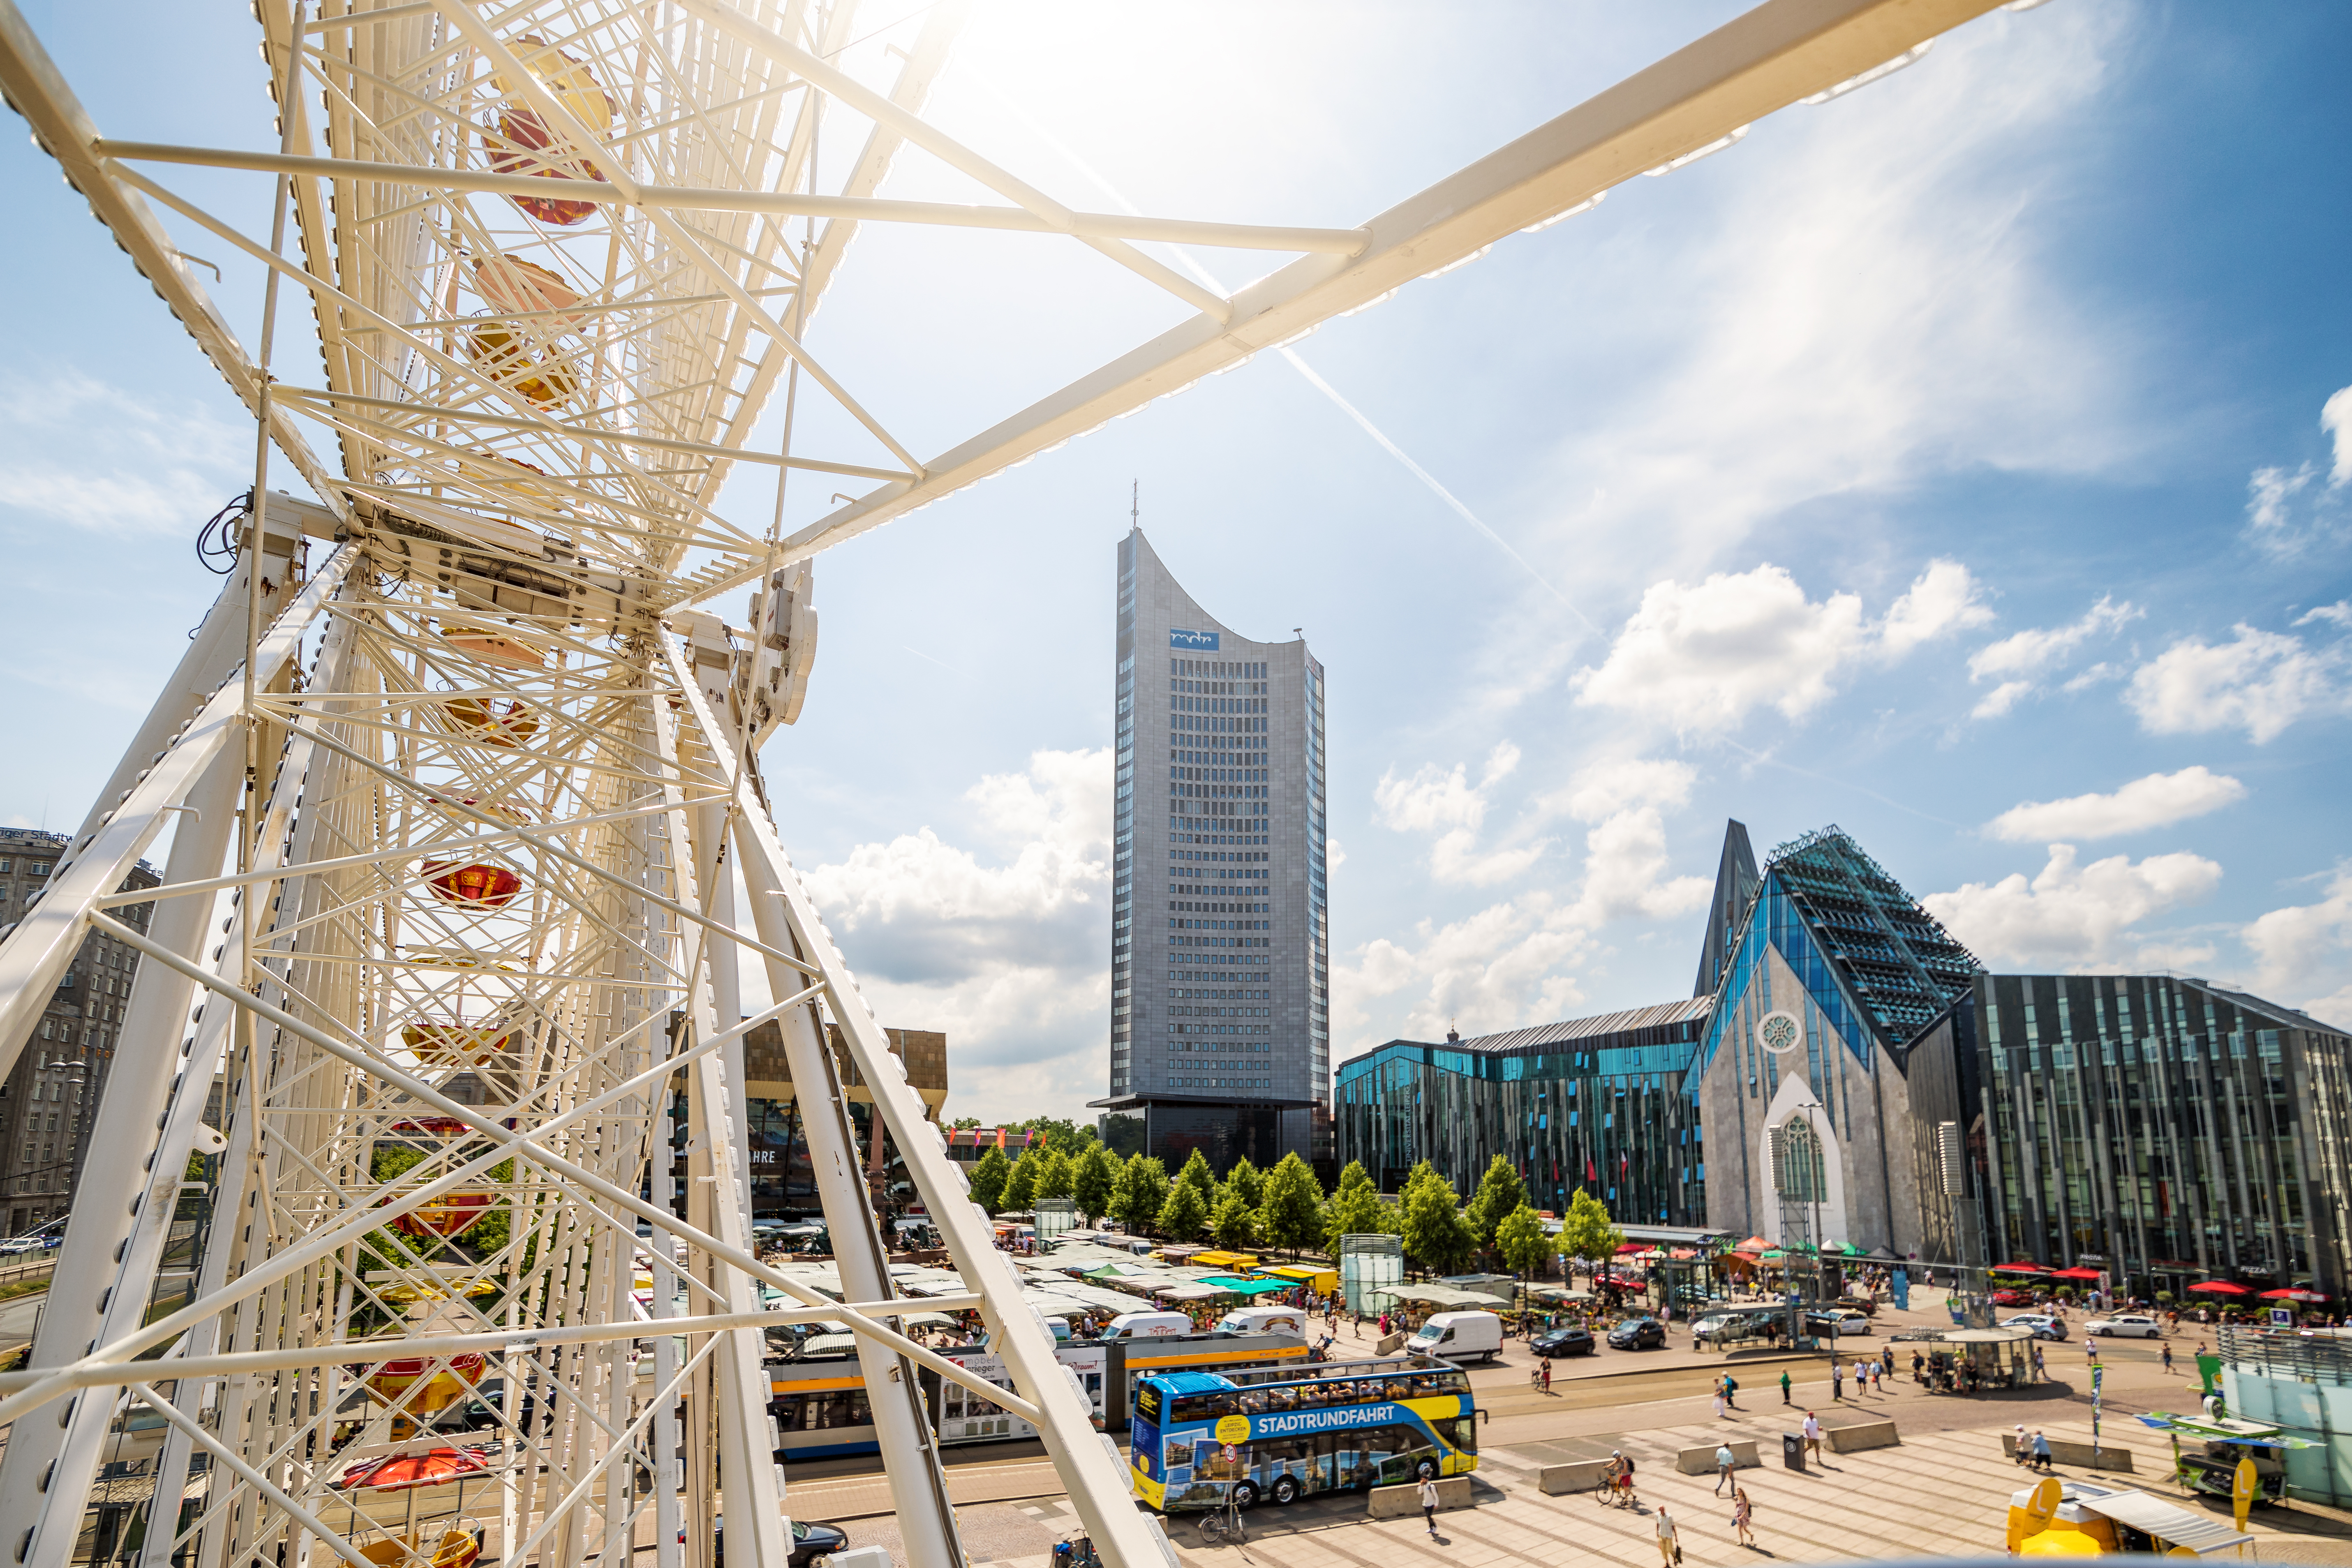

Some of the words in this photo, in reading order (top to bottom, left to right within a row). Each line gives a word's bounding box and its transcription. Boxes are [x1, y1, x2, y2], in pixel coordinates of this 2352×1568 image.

[1171, 631, 1211, 644] mdr
[0, 829, 27, 839] iger
[966, 1355, 994, 1365] möbel
[1259, 1406, 1395, 1433] STADTRUNDFAHRT
[1227, 1448, 1234, 1458] 20
